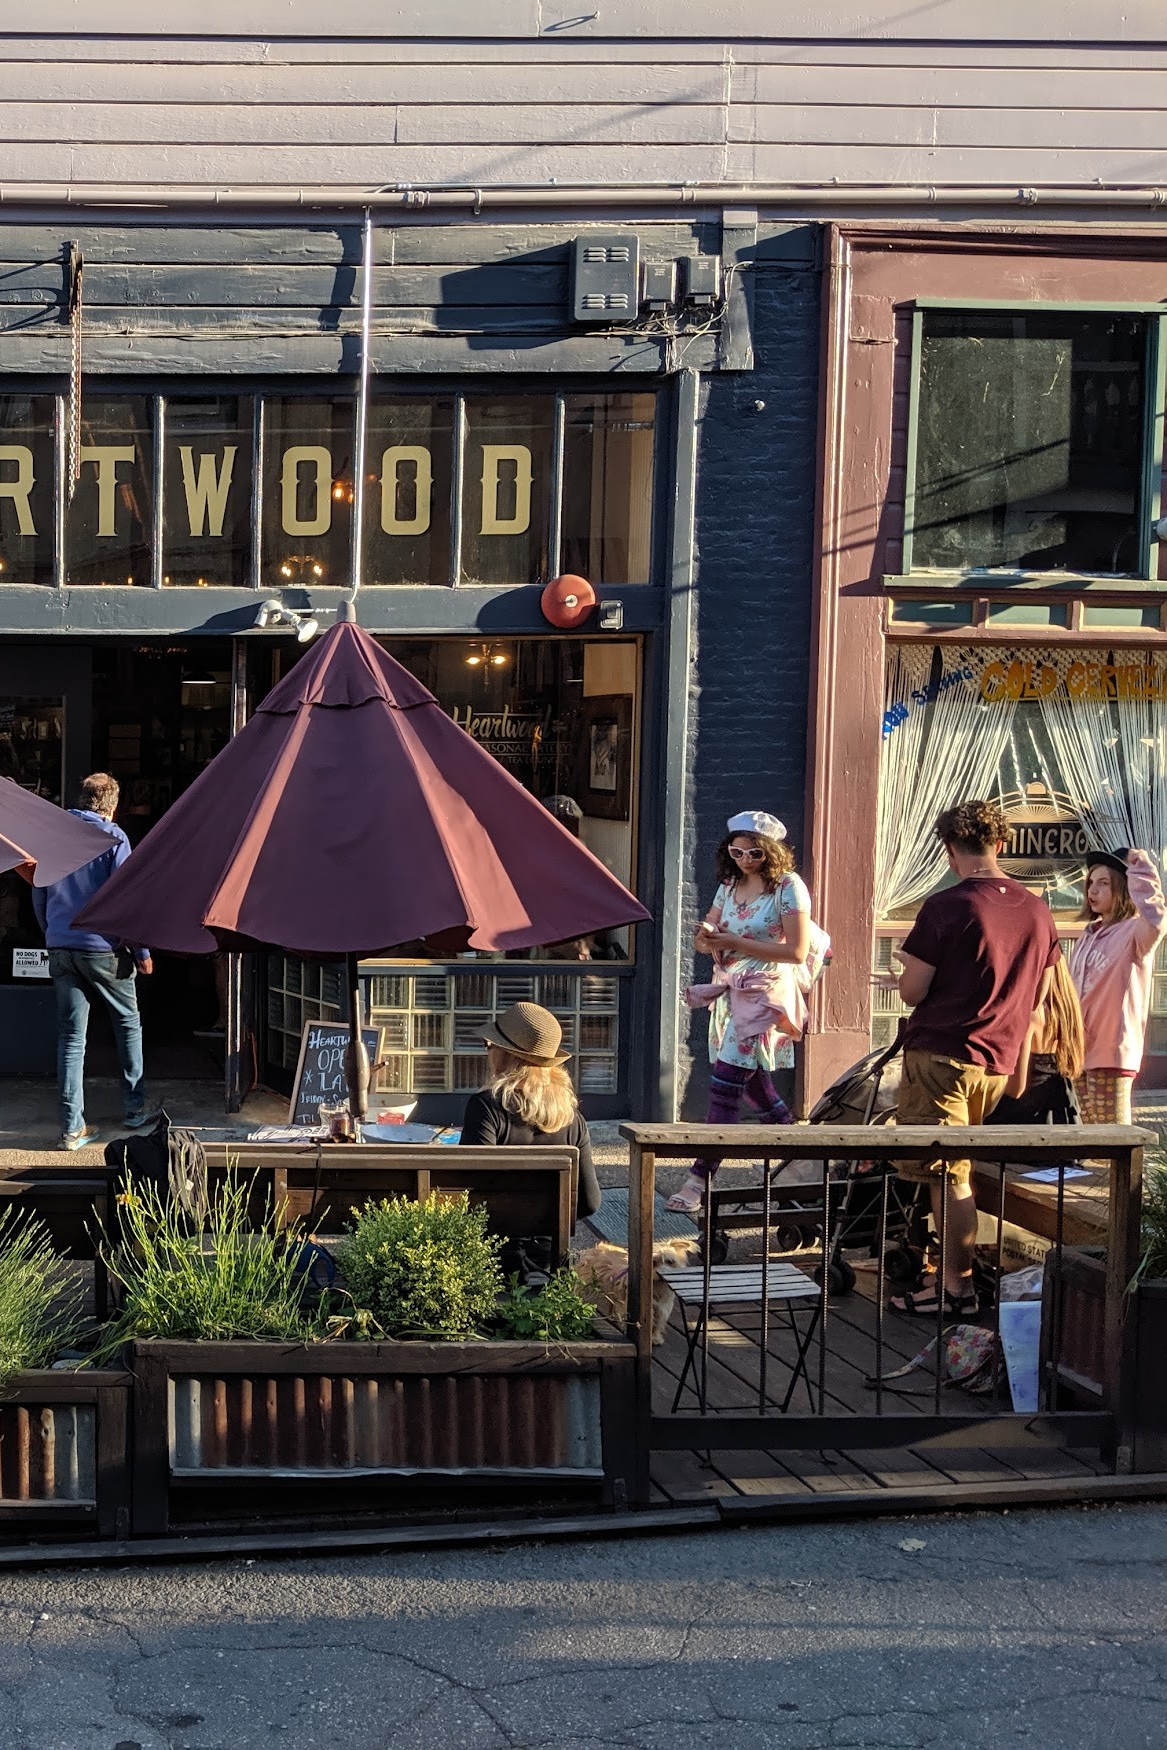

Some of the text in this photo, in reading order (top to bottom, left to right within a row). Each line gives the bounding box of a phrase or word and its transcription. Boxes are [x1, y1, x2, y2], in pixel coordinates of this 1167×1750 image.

[982, 661, 1058, 703] COLD
[482, 743, 528, 753] ASONAL
[308, 1029, 350, 1050] HEARTW
[317, 1048, 346, 1073] OPE
[1027, 1245, 1046, 1258] STAT
